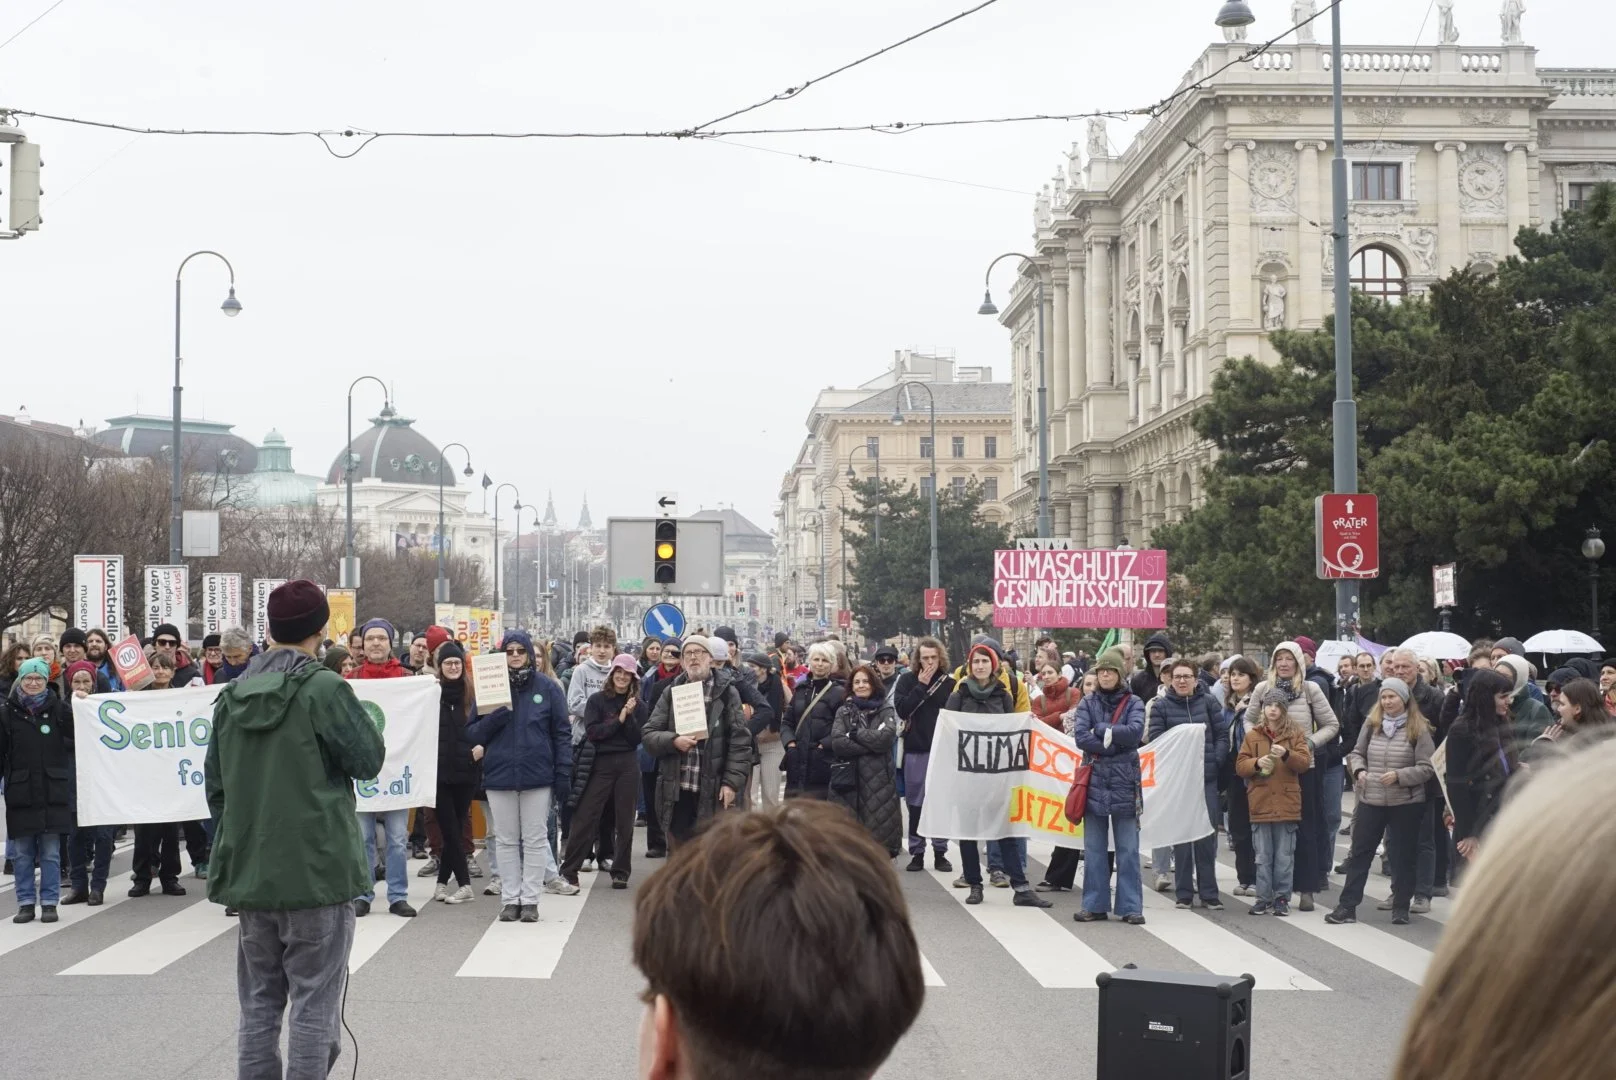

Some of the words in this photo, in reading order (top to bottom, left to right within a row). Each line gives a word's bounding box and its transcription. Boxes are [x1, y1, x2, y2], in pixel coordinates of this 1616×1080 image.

[1332, 517, 1368, 530] PRATER
[994, 551, 1139, 581] KLIMASCHUTZ
[1141, 555, 1163, 577] IST
[150, 570, 160, 603] wien
[163, 571, 173, 617] karlsplatz
[208, 576, 217, 606] wien
[220, 577, 228, 620] karlsplatz
[993, 580, 1165, 608] GESUNDHEITSSCHUTZ
[80, 585, 88, 632] museum
[149, 605, 160, 634] alle
[207, 608, 217, 634] alle
[120, 648, 137, 665] 100
[98, 700, 210, 750] Senio
[178, 759, 204, 786] fo
[356, 765, 413, 799] e.at
